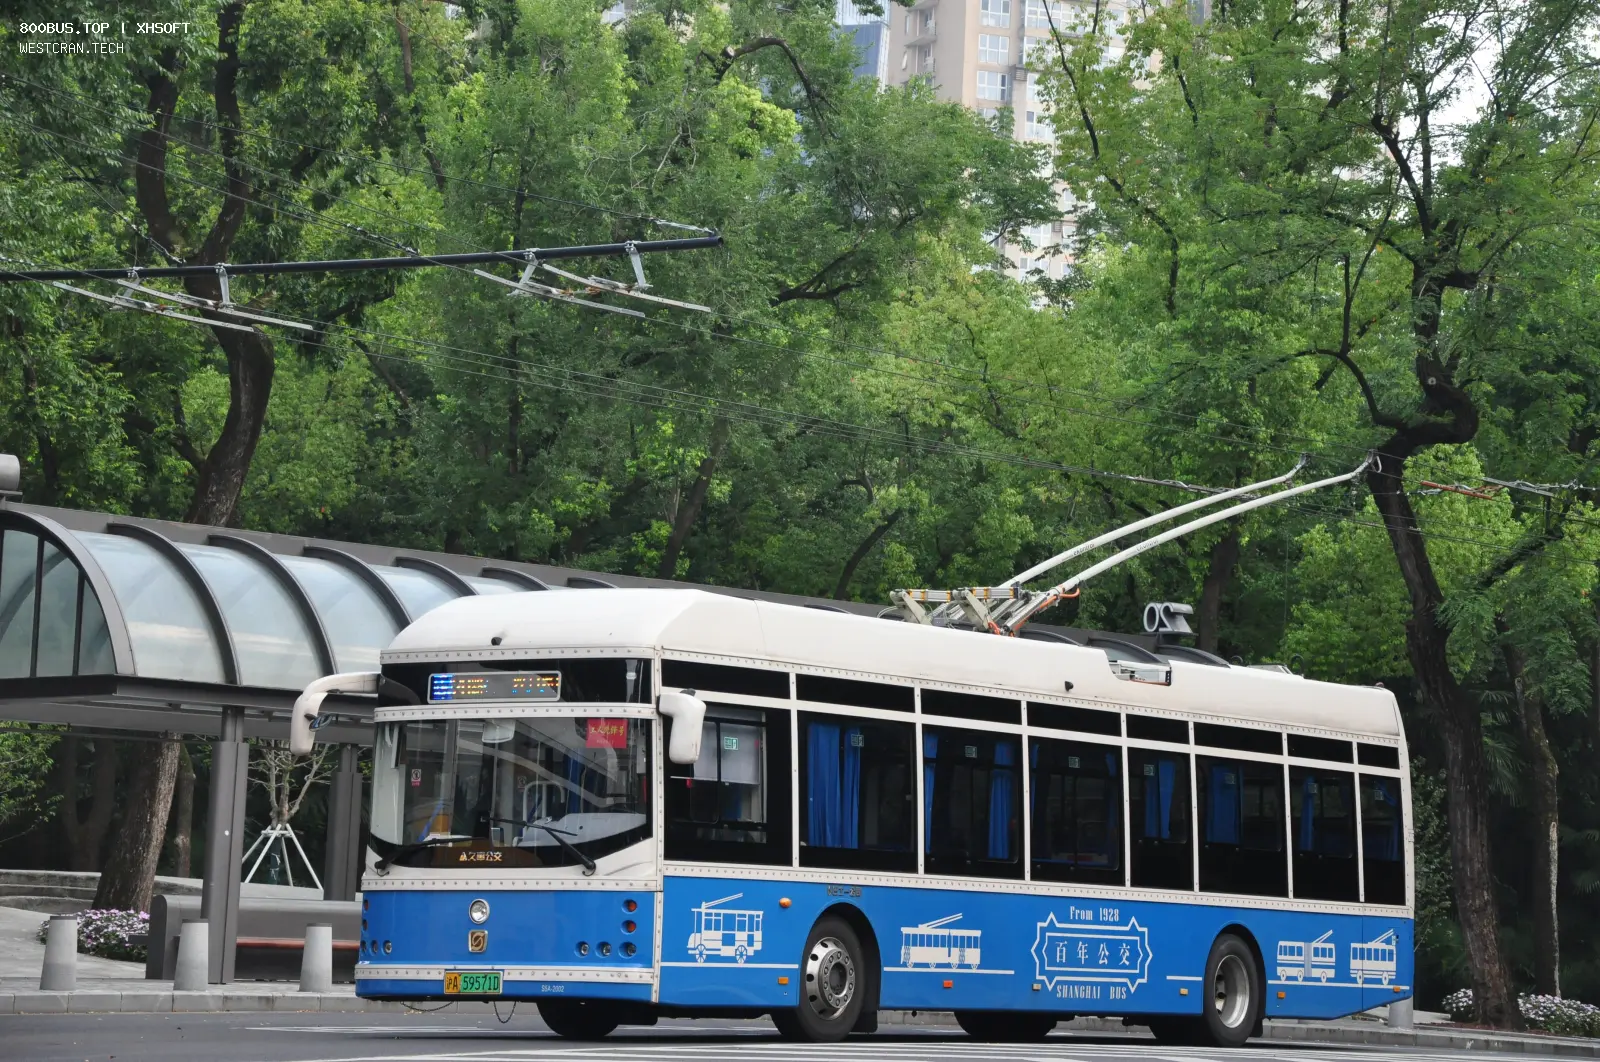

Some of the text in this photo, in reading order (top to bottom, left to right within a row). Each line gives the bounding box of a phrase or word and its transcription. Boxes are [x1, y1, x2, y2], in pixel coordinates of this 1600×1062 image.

[1069, 905, 1120, 922] From 1928
[1055, 940, 1131, 966] 百年公交
[462, 976, 499, 991] 59571D
[1056, 984, 1127, 1000] SHANGHAI BUS
